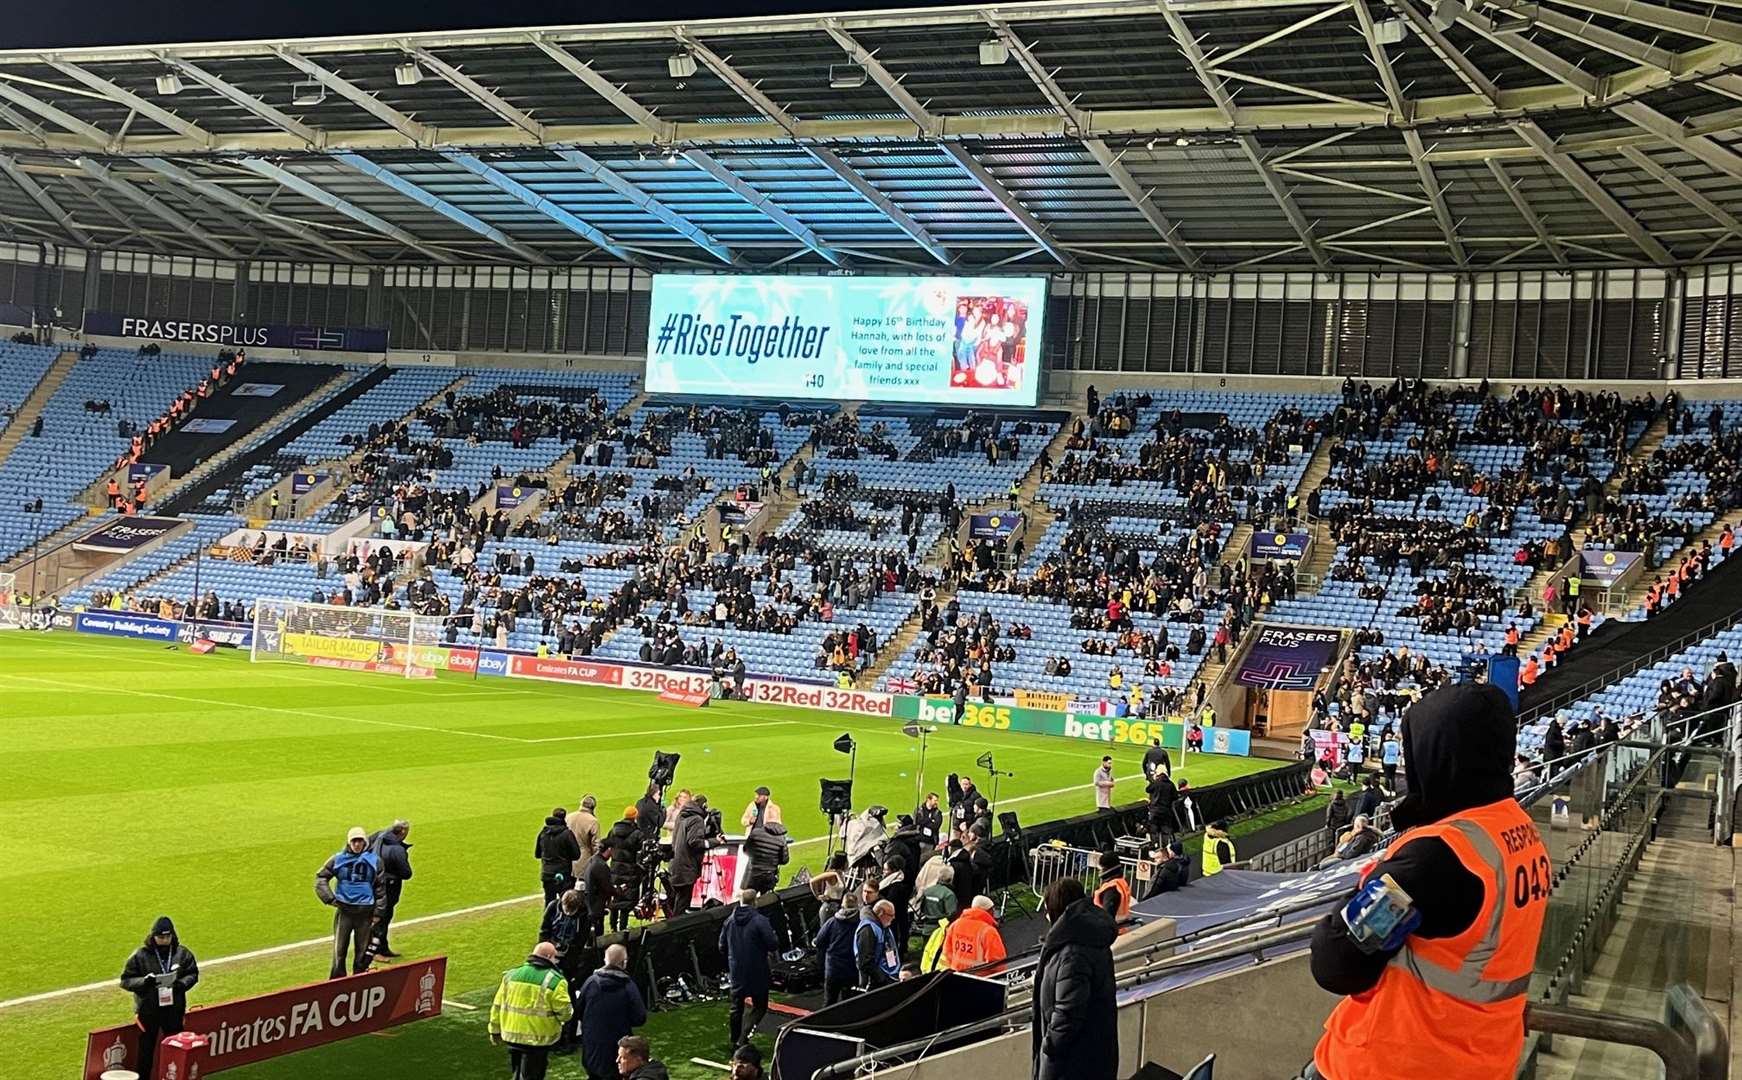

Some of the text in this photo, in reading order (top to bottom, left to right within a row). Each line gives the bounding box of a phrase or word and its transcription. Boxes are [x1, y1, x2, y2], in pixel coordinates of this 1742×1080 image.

[853, 317, 882, 327] Happy
[906, 317, 945, 328] Birthday
[656, 313, 830, 364] #RiseTogether
[851, 332, 946, 342] Hannah, with lots of
[859, 346, 935, 356] love from all the
[565, 359, 573, 367] 11
[855, 360, 938, 371] family and special
[869, 376, 902, 384] friends
[1220, 378, 1226, 388] 8
[82, 617, 114, 631] Coventry
[114, 620, 143, 634] Building
[144, 624, 171, 637] Society
[1259, 637, 1300, 648] PLUS
[1262, 630, 1338, 642] FRASERS
[302, 637, 338, 651] TAILOR
[341, 641, 373, 655] MADE
[449, 653, 478, 670] ebay
[480, 655, 507, 672] ebay
[568, 667, 578, 675] FA
[579, 668, 598, 677] CUP
[630, 671, 690, 693] 32Red
[758, 684, 822, 706] 32Red
[825, 690, 891, 714] 32Red
[1064, 714, 1164, 746] bet365
[1514, 855, 1551, 909] 043
[955, 940, 974, 954] 032
[289, 1000, 323, 1038] FA
[328, 985, 386, 1027] CUP
